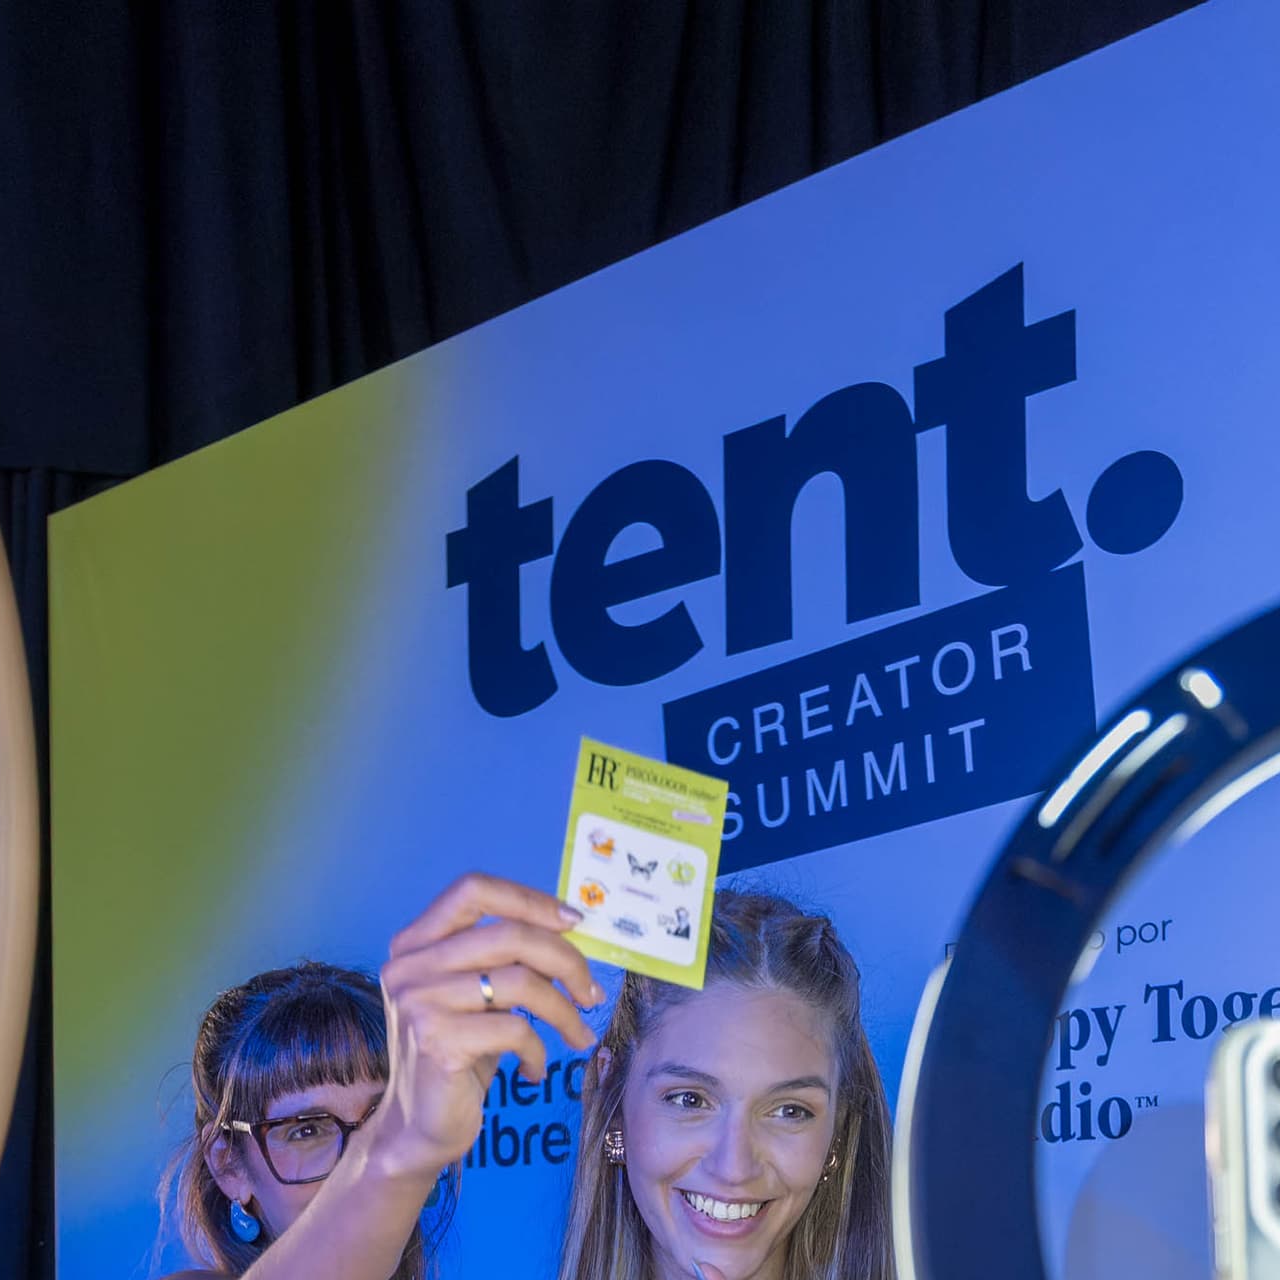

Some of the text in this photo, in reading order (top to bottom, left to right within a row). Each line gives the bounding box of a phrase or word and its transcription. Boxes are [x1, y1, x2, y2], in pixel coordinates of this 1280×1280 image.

[445, 261, 1184, 719] tent.
[706, 623, 1033, 766] CREATOR
[1116, 919, 1173, 954] por
[466, 1113, 571, 1169] ibre
